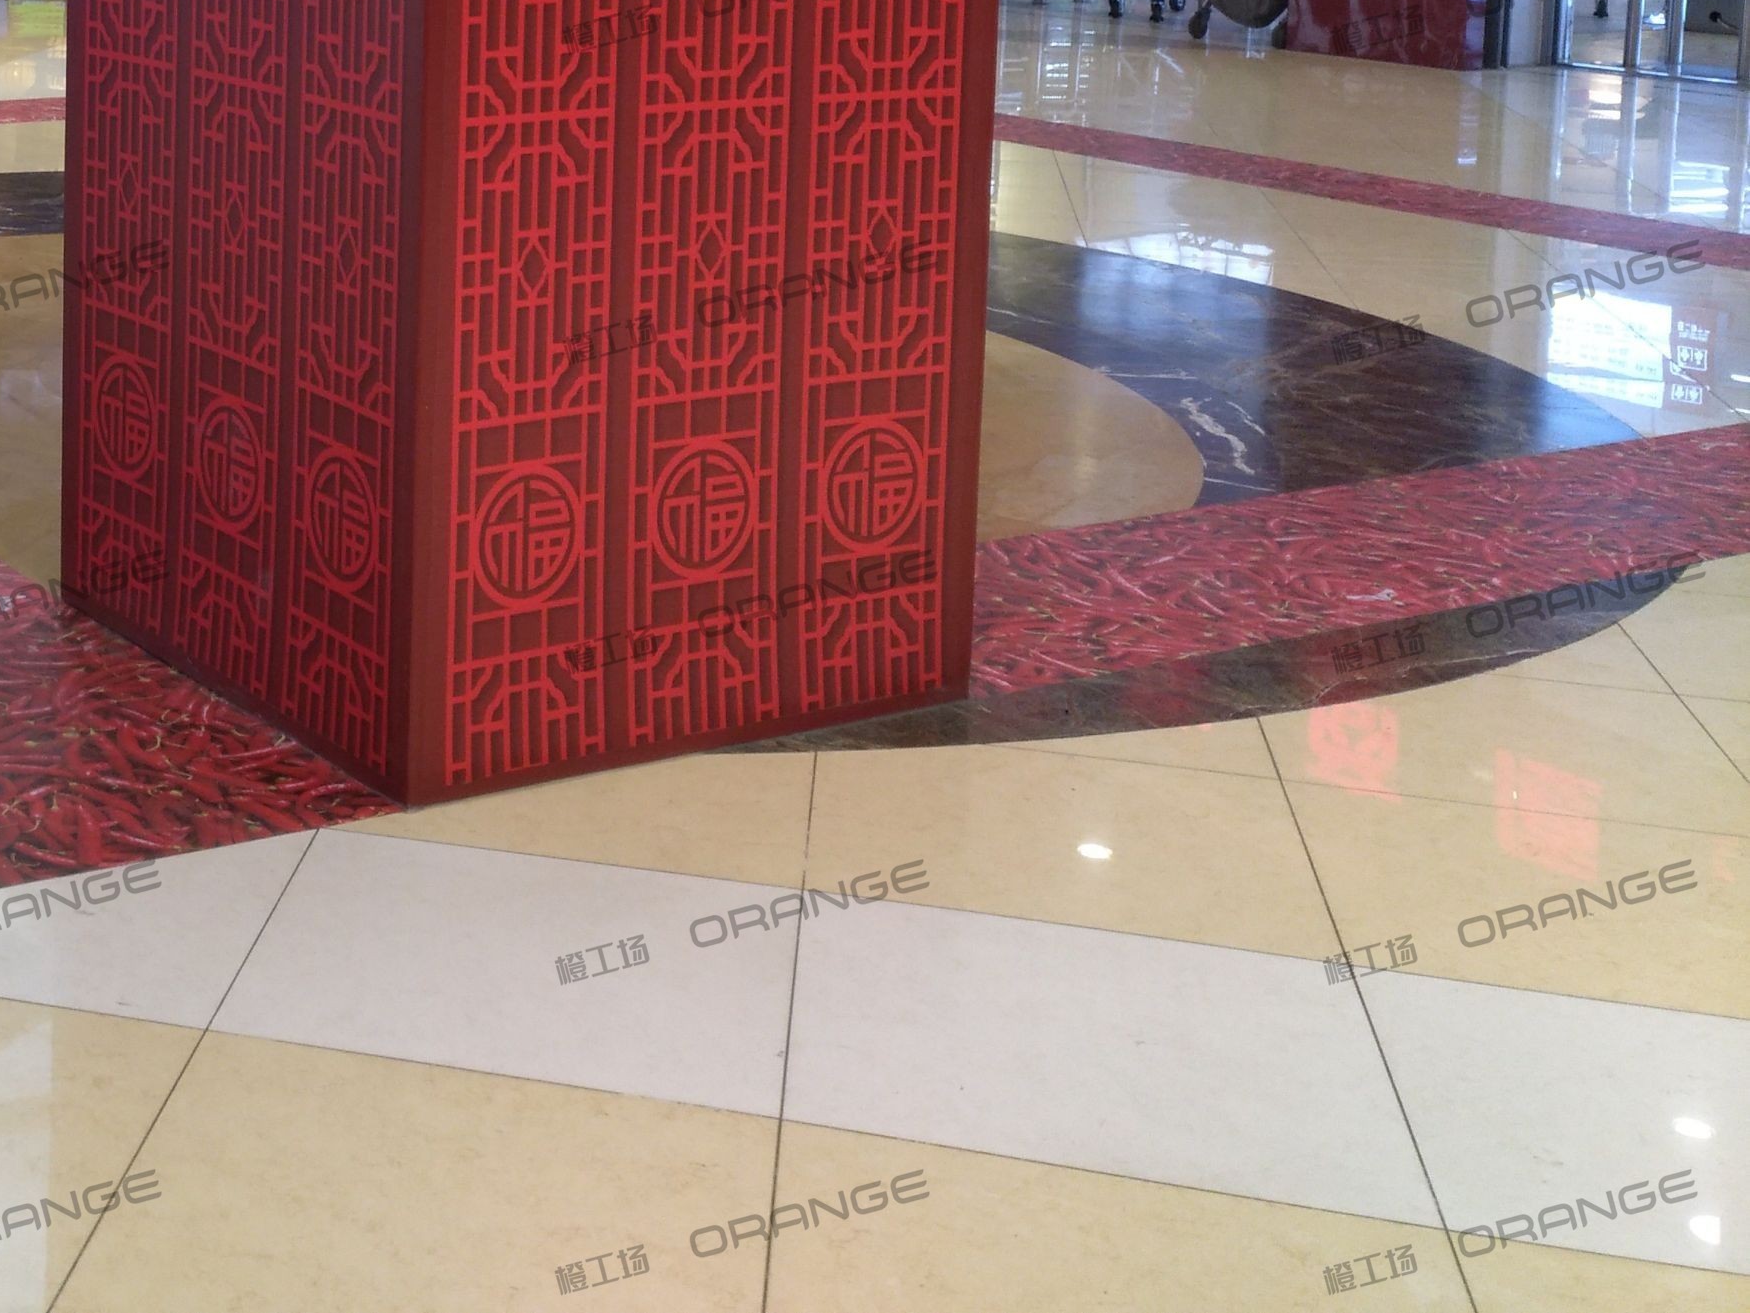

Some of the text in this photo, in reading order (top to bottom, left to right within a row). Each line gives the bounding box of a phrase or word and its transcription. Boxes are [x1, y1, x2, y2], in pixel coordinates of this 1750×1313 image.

[485, 478, 571, 591] 福
[662, 454, 745, 561] 福
[833, 431, 914, 536] 福
